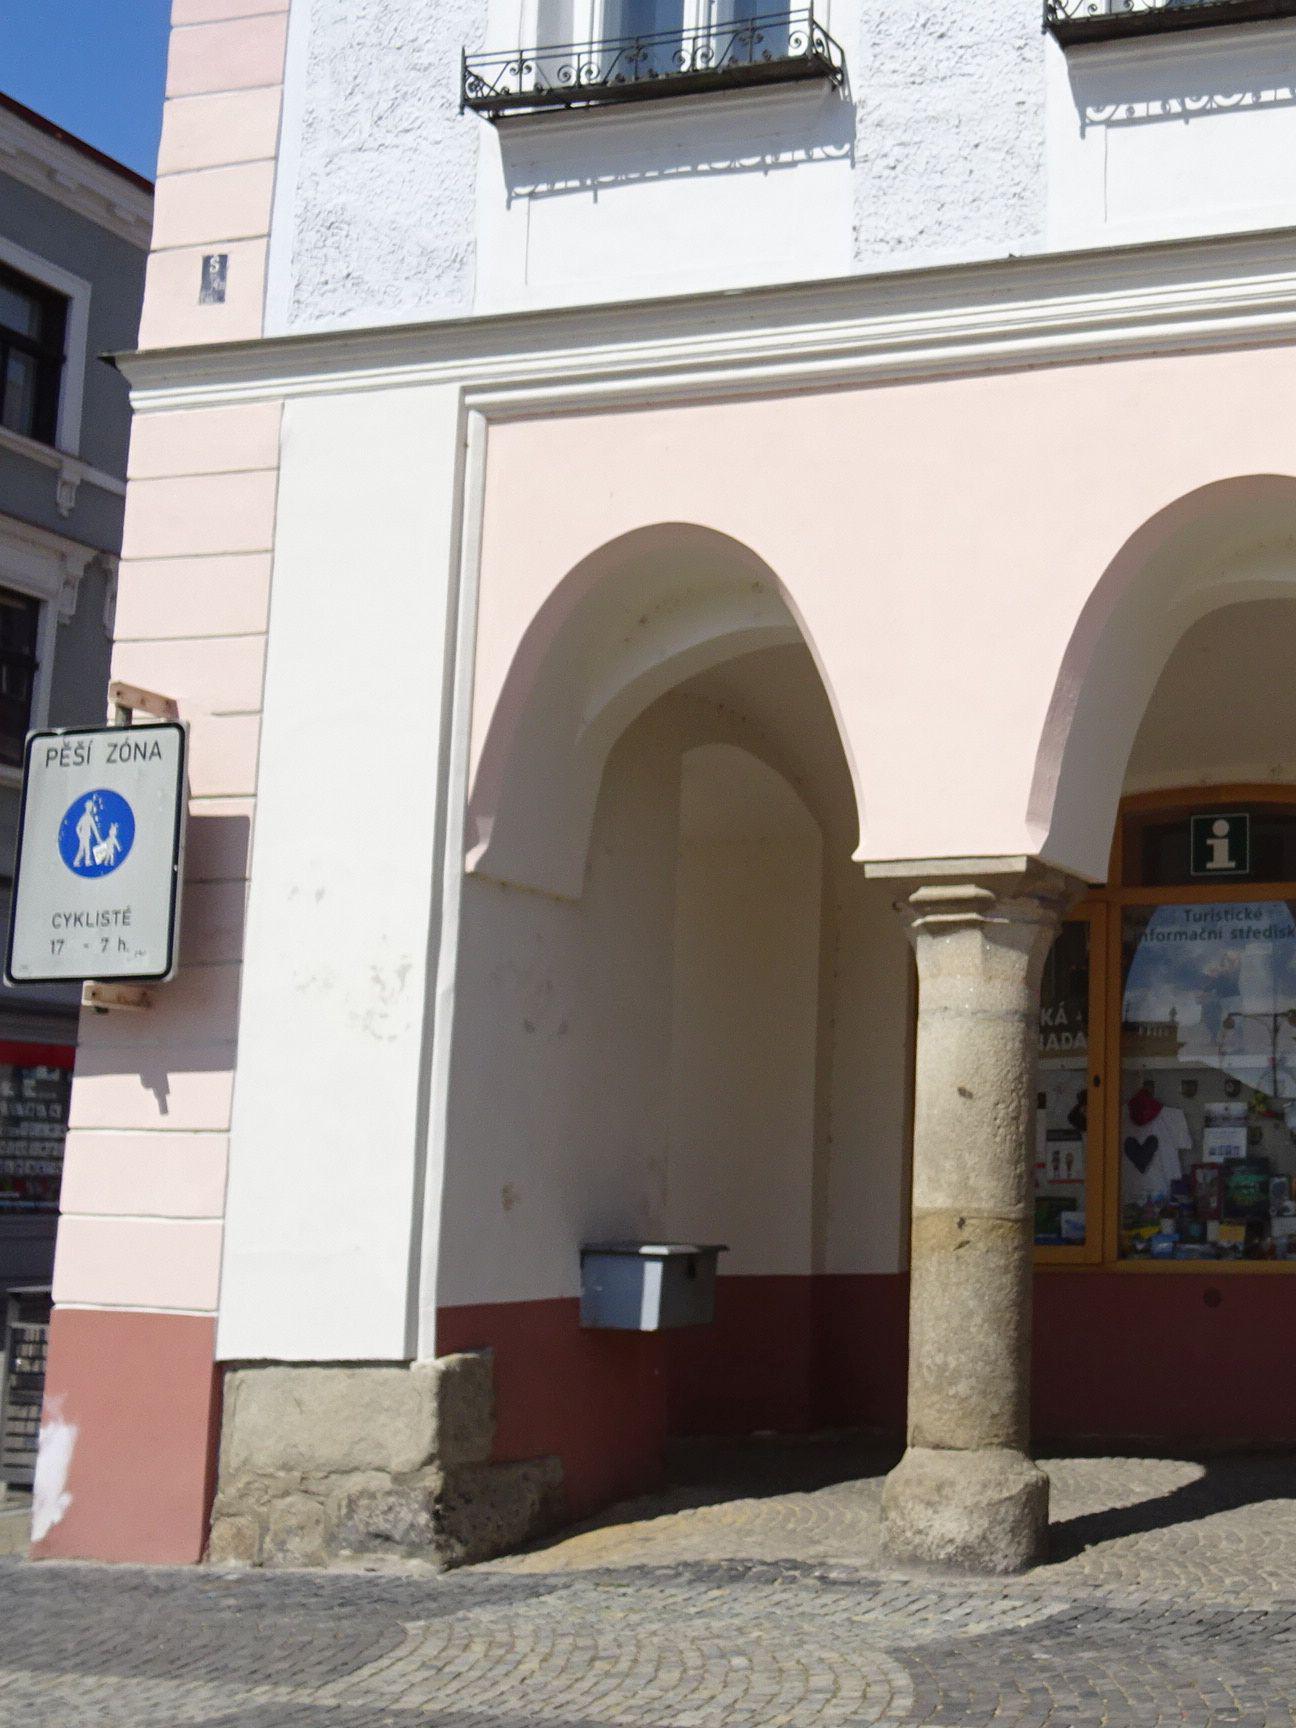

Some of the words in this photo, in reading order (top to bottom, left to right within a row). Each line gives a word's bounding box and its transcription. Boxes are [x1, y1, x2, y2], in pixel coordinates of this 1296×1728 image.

[45, 740, 94, 769] PĚŠÍ
[106, 737, 162, 764] ZÓNA
[51, 906, 132, 929] CYKLISTÉ
[1184, 907, 1263, 922] Turistické
[50, 938, 65, 955] 17
[101, 937, 110, 953] 7
